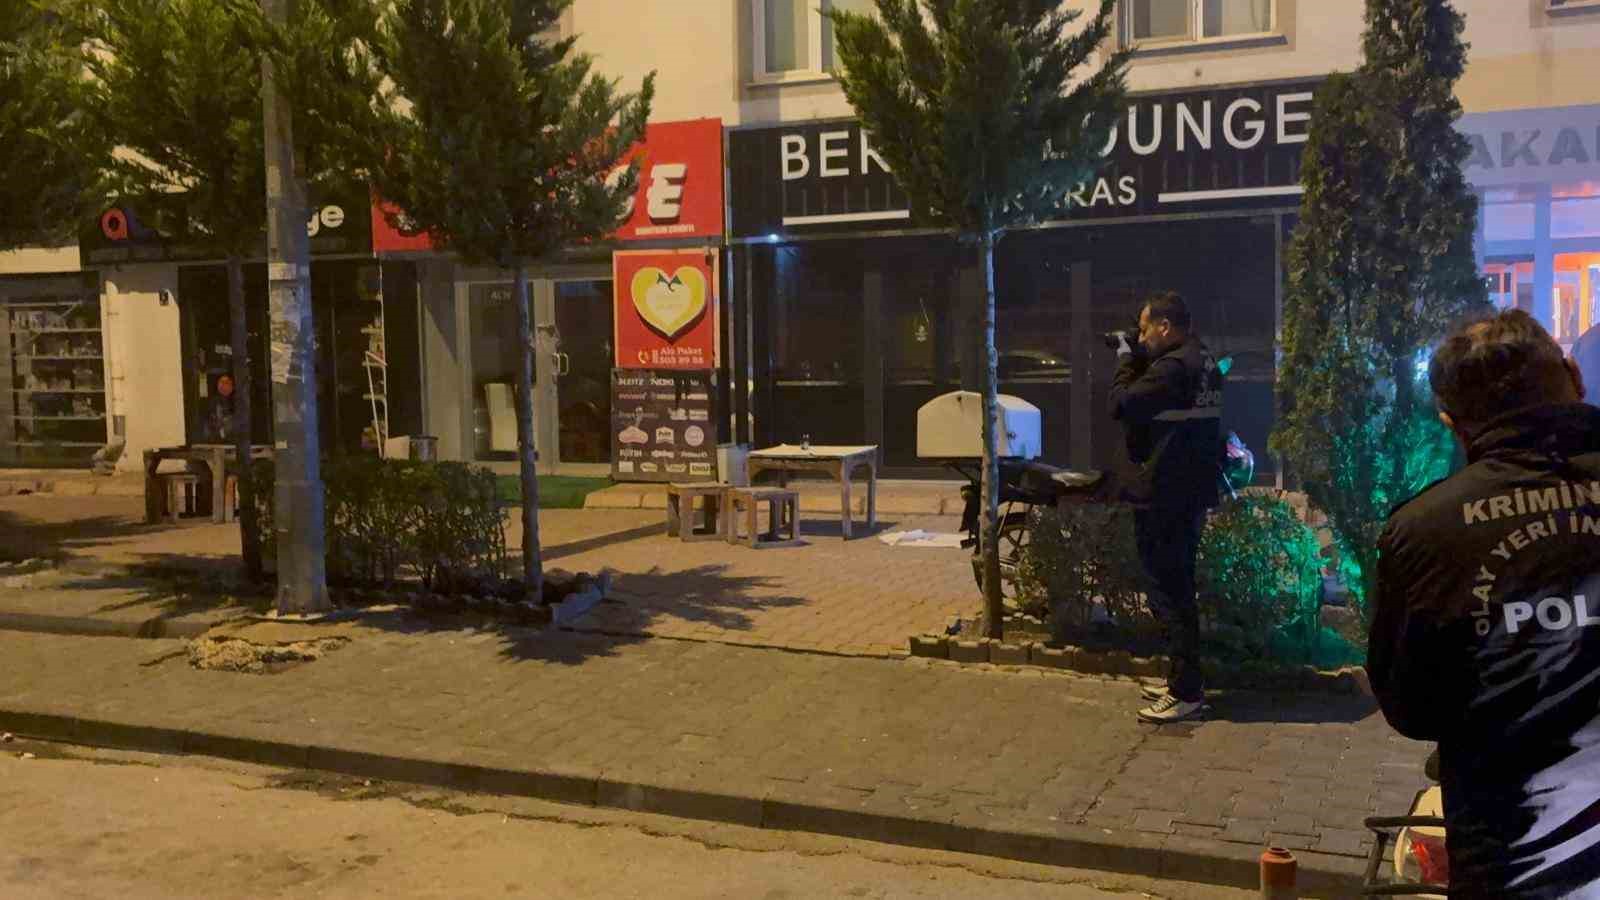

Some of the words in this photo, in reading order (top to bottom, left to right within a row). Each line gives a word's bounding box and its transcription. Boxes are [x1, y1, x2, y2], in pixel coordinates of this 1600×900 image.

[1461, 125, 1600, 169] AKA
[1471, 565, 1496, 636] OLAY
[1490, 514, 1558, 560] YERİ
